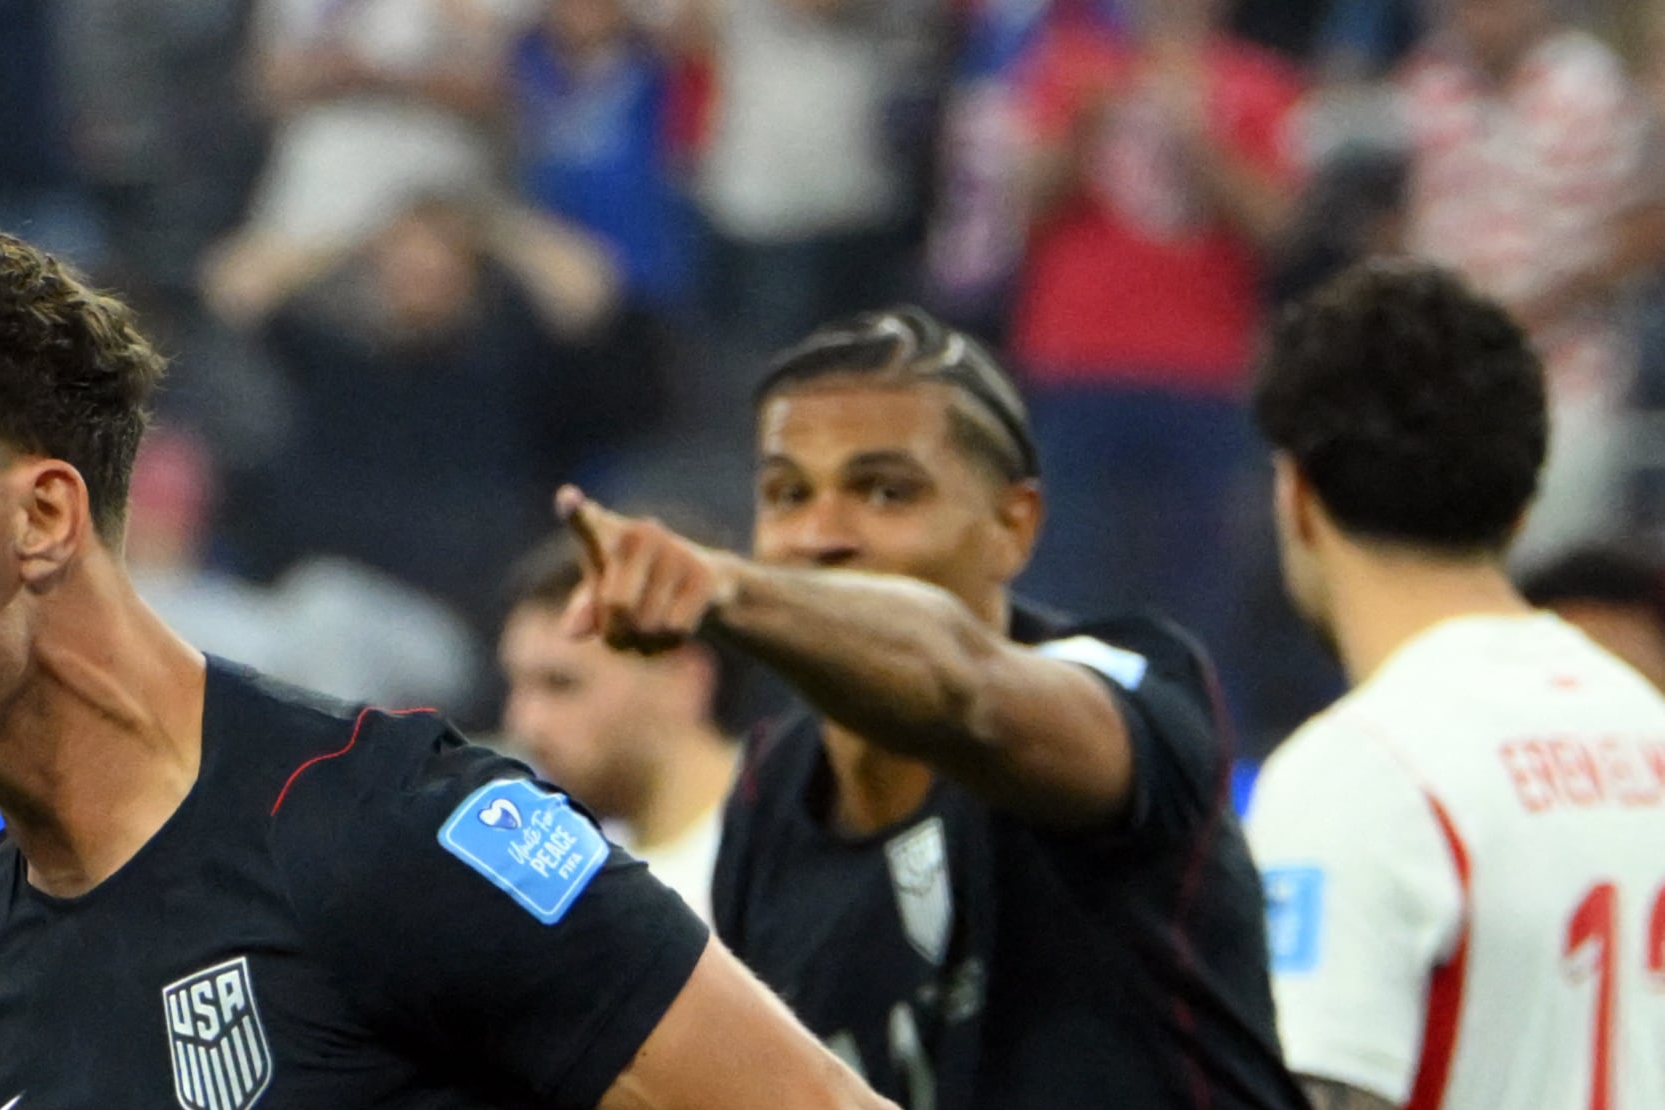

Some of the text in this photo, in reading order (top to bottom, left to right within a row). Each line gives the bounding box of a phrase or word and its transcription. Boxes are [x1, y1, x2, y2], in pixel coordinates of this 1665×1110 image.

[530, 825, 577, 878] PEACE
[558, 853, 584, 879] FIFA
[168, 969, 246, 1041] USA
